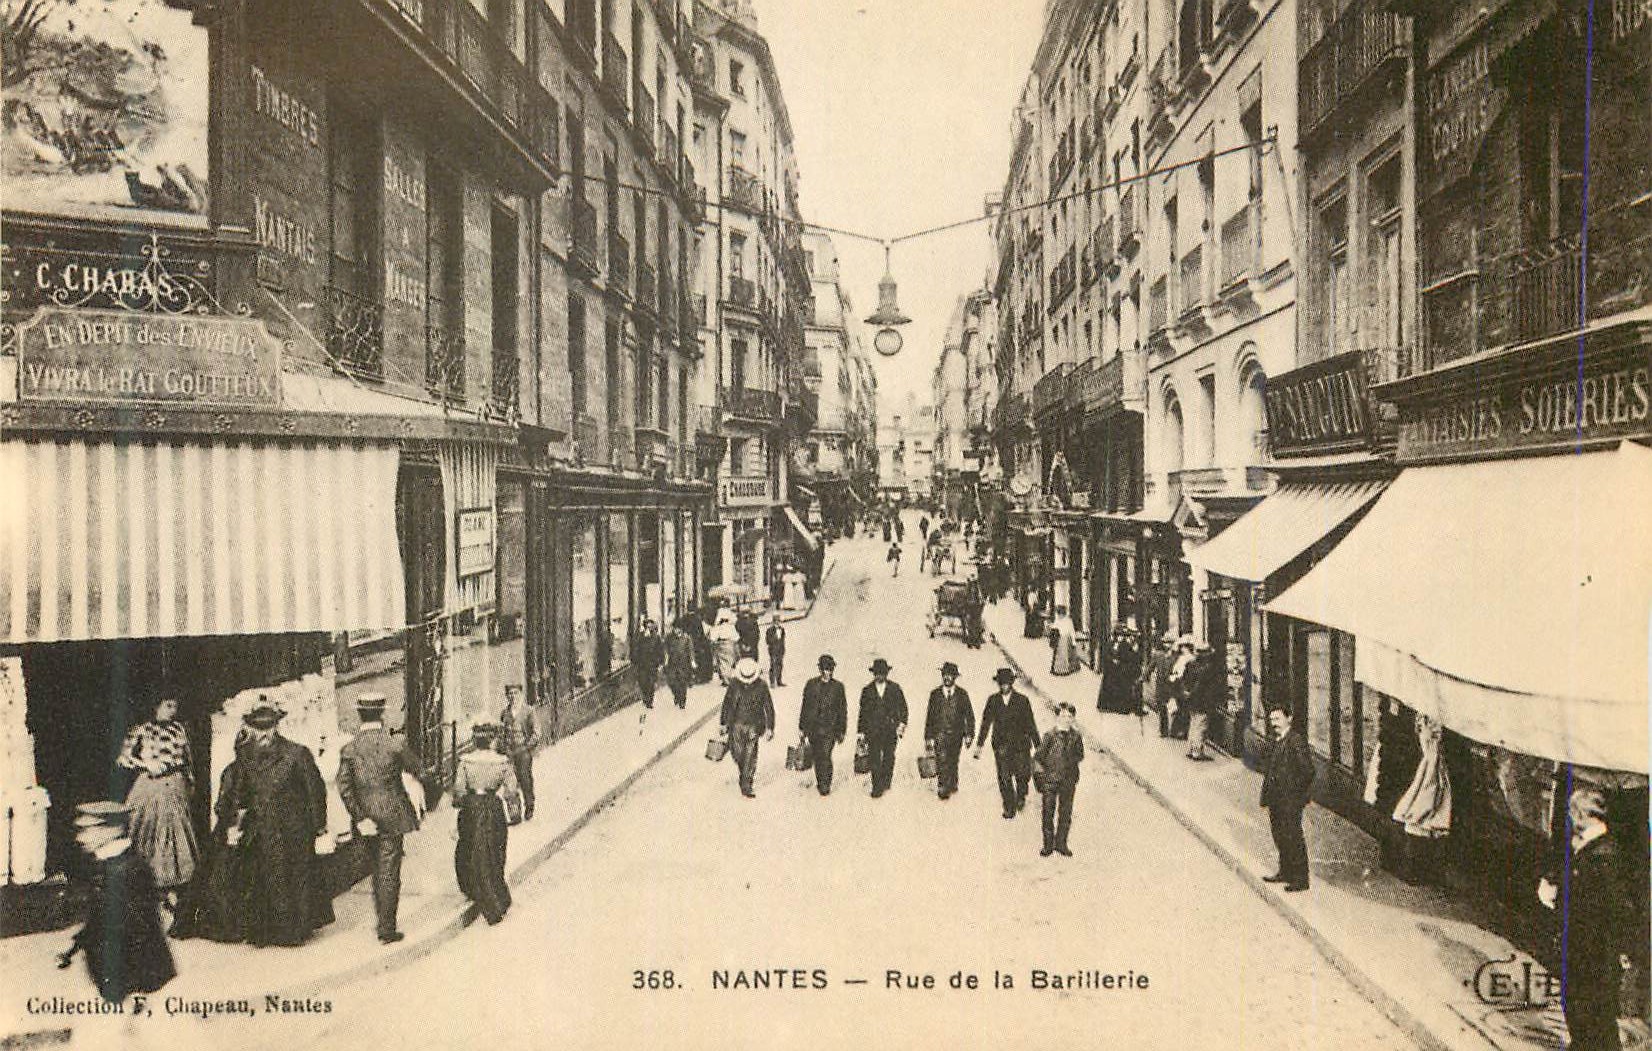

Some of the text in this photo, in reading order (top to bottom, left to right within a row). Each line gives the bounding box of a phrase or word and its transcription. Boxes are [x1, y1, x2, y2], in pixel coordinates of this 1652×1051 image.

[250, 64, 318, 146] TIMBRES
[252, 193, 316, 265] NANTAIS
[63, 263, 179, 302] CHABAS
[46, 324, 73, 350] EN
[137, 322, 171, 345] des
[178, 322, 257, 360] ENVIEUX
[27, 363, 92, 392] VIVRA
[1518, 368, 1649, 436] SOIERIES
